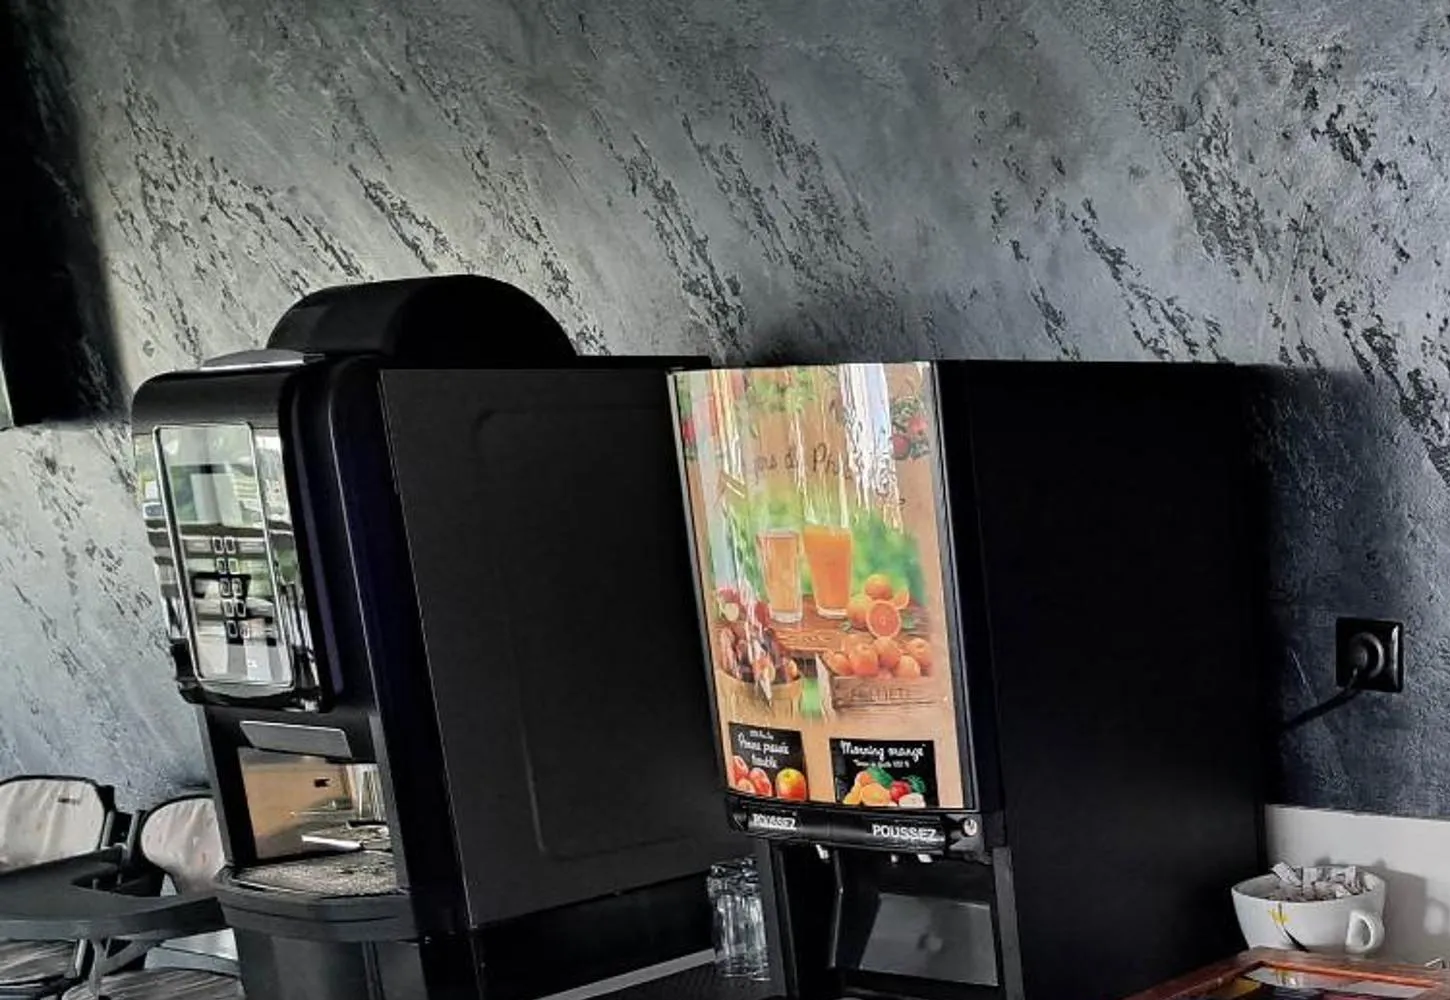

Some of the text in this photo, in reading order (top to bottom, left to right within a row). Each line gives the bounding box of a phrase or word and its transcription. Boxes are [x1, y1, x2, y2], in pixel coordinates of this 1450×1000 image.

[840, 739, 924, 763] Morning orange
[752, 812, 797, 831] POUSSEZ
[871, 823, 938, 841] POUSSEZ
